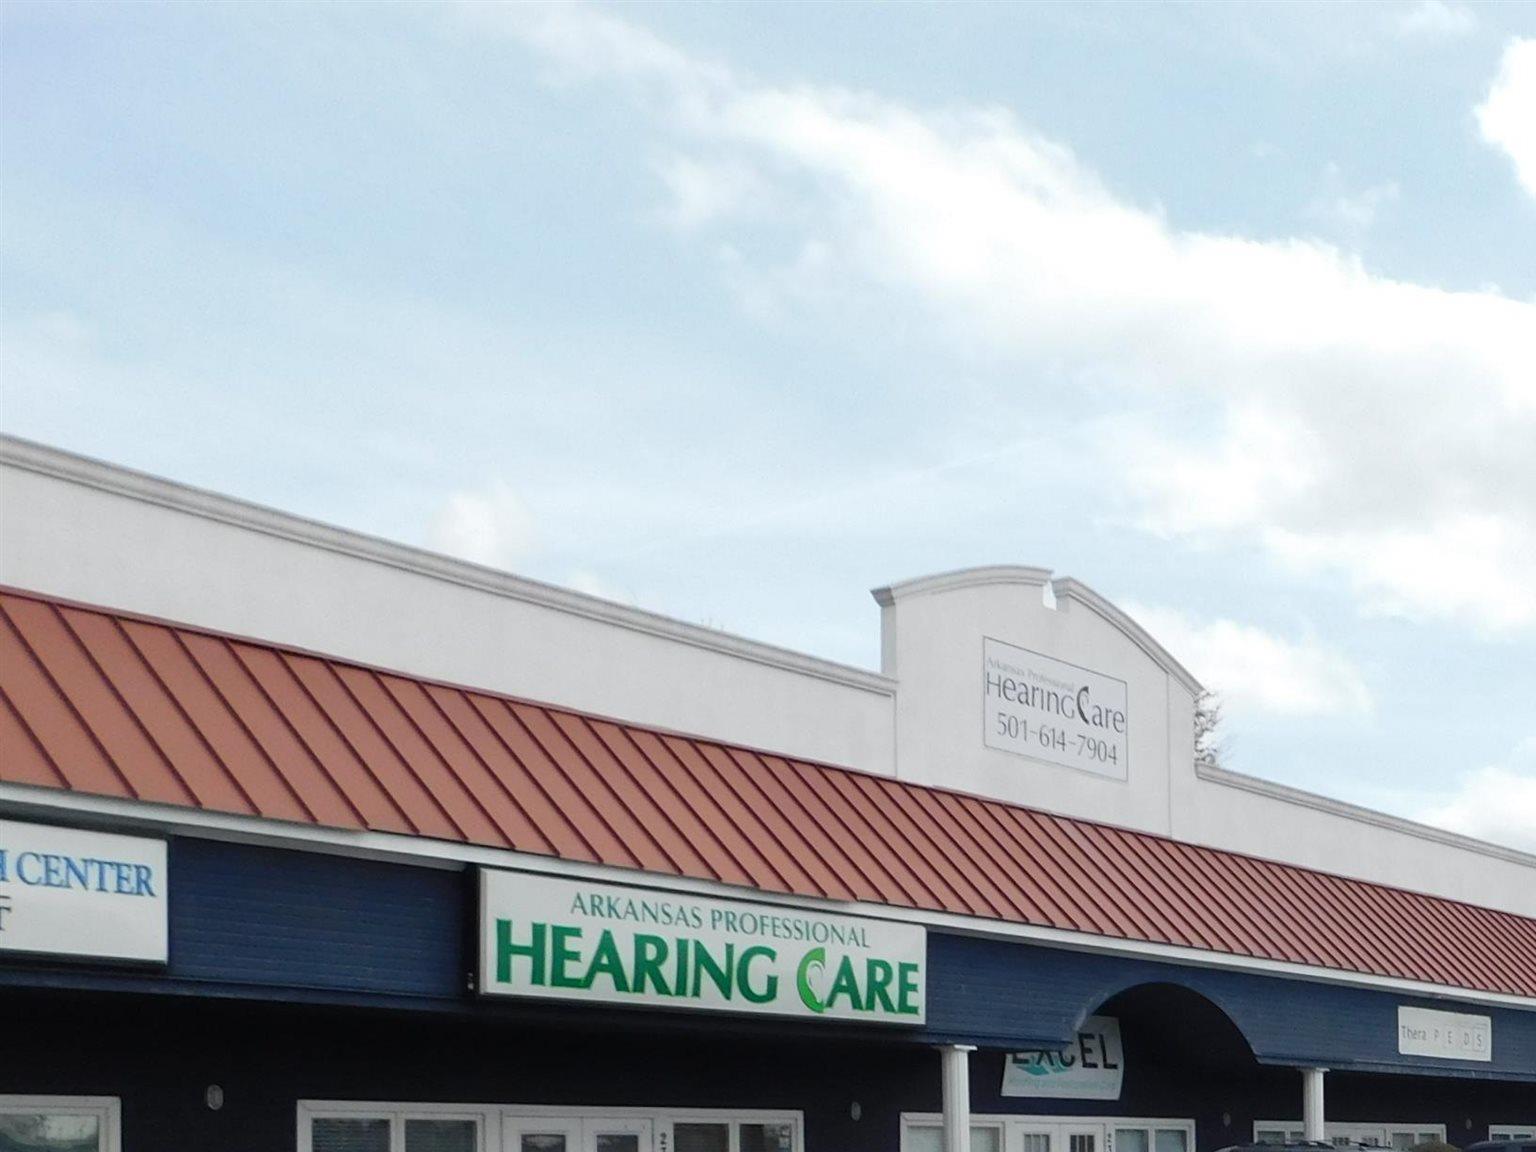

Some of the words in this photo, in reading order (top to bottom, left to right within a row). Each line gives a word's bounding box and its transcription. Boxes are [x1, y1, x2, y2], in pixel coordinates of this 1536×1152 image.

[997, 711, 1119, 766] 501-614-7904
[16, 851, 157, 897] CENTER
[570, 892, 703, 929] ARKANSAS
[710, 910, 872, 949] PROFESSIONAL
[495, 917, 779, 1004] HEARING
[796, 946, 920, 1015] CARE
